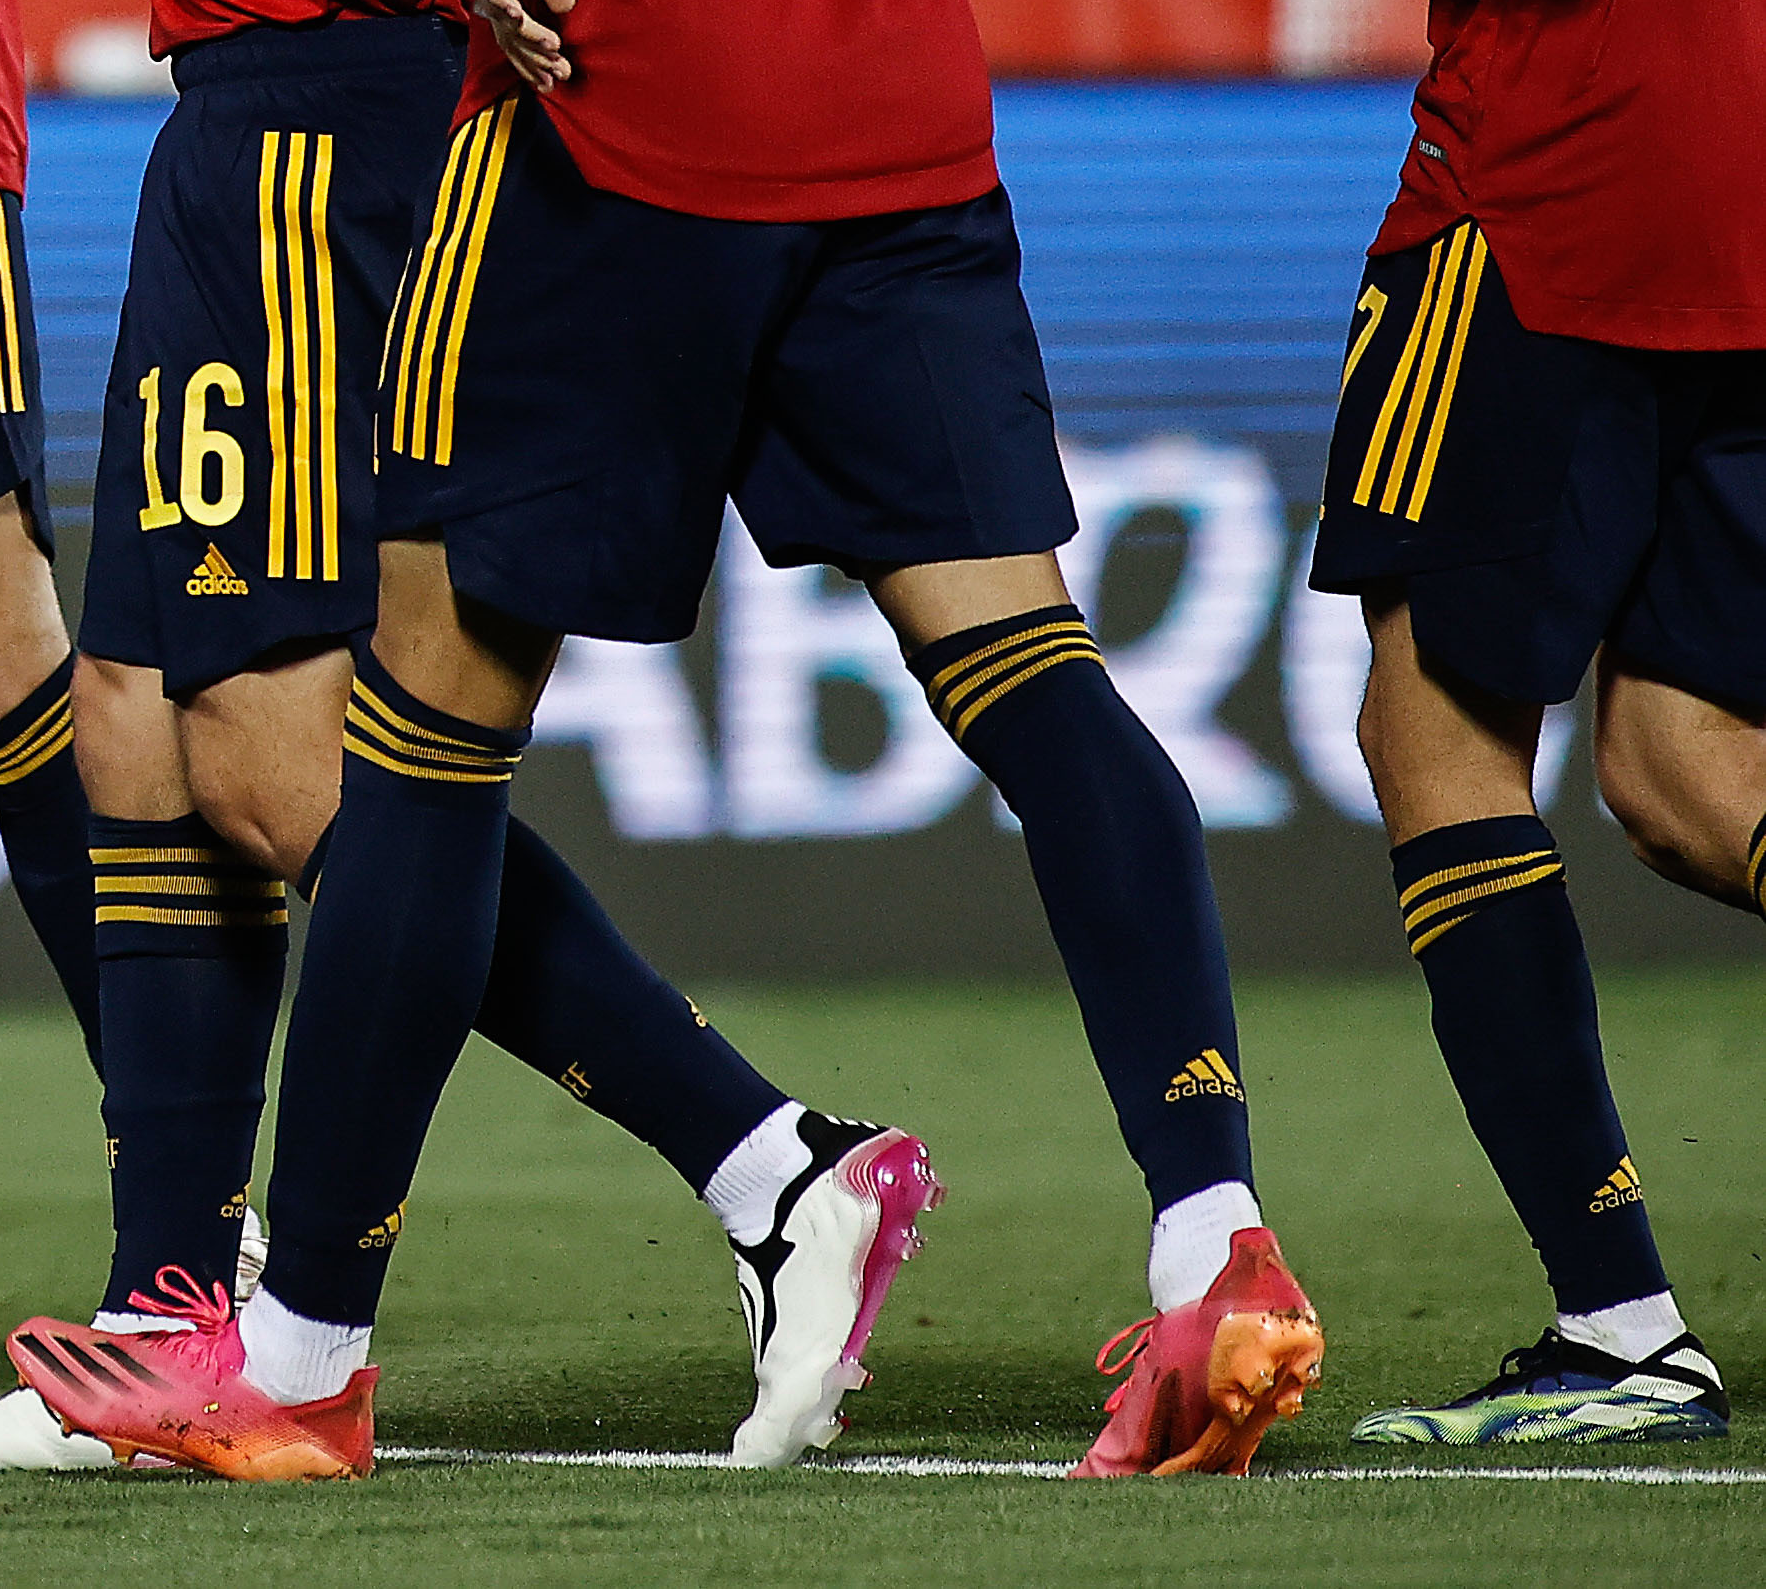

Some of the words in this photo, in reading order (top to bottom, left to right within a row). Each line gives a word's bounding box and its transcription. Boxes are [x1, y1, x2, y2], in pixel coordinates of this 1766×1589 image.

[138, 362, 245, 531] 16
[186, 574, 250, 597] adidas
[1165, 1077, 1245, 1104] adidas
